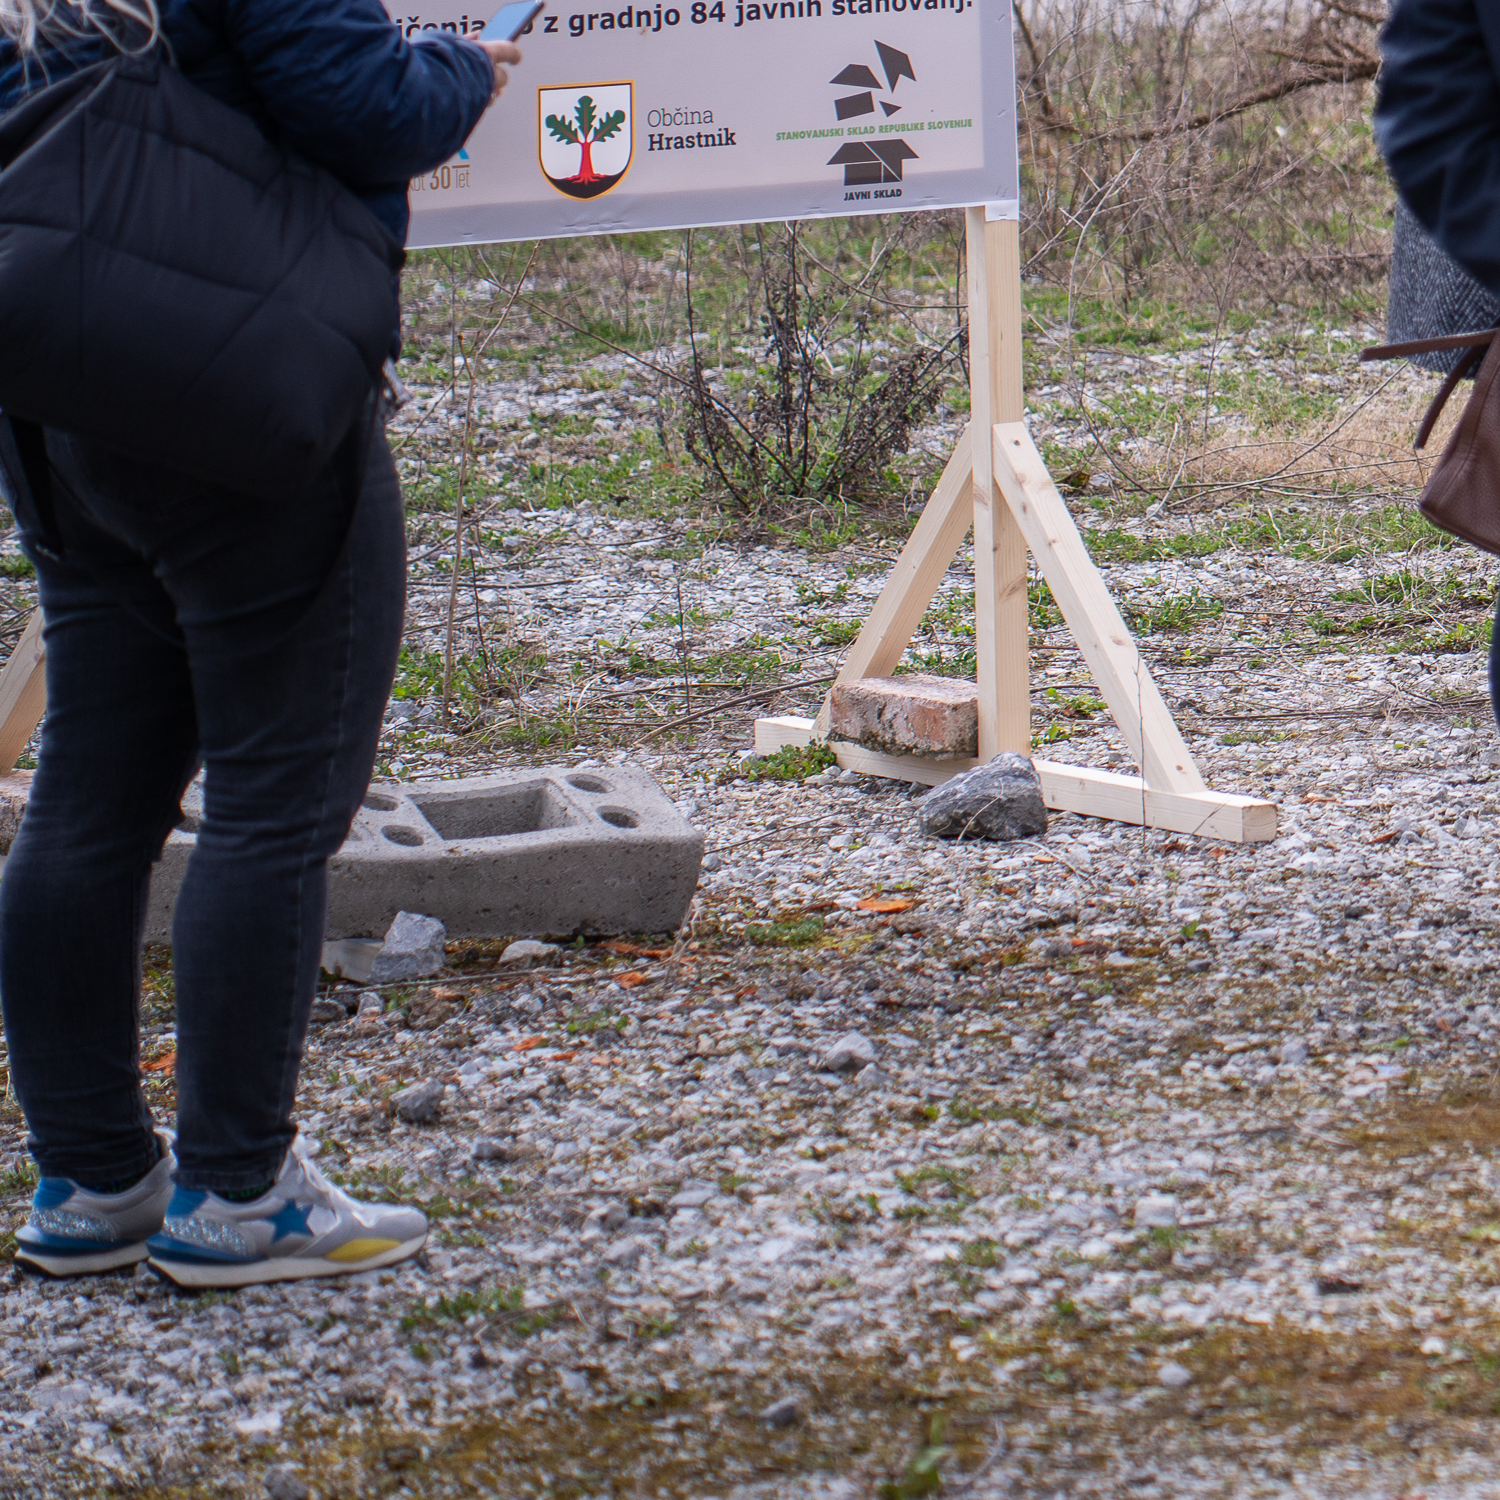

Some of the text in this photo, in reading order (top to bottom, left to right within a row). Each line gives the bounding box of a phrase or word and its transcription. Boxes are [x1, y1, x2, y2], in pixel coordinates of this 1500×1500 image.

[543, 15, 559, 33] z
[567, 4, 682, 38] gradnjo
[690, 0, 726, 25] 84
[646, 106, 714, 128] Občina
[647, 127, 737, 152] Hrastnik
[775, 118, 973, 141] STANOVANJSKI SKLAD REPUBLIKE SLOVENIJE
[455, 168, 471, 189] let
[844, 188, 903, 202] JAVNI SKLAD
